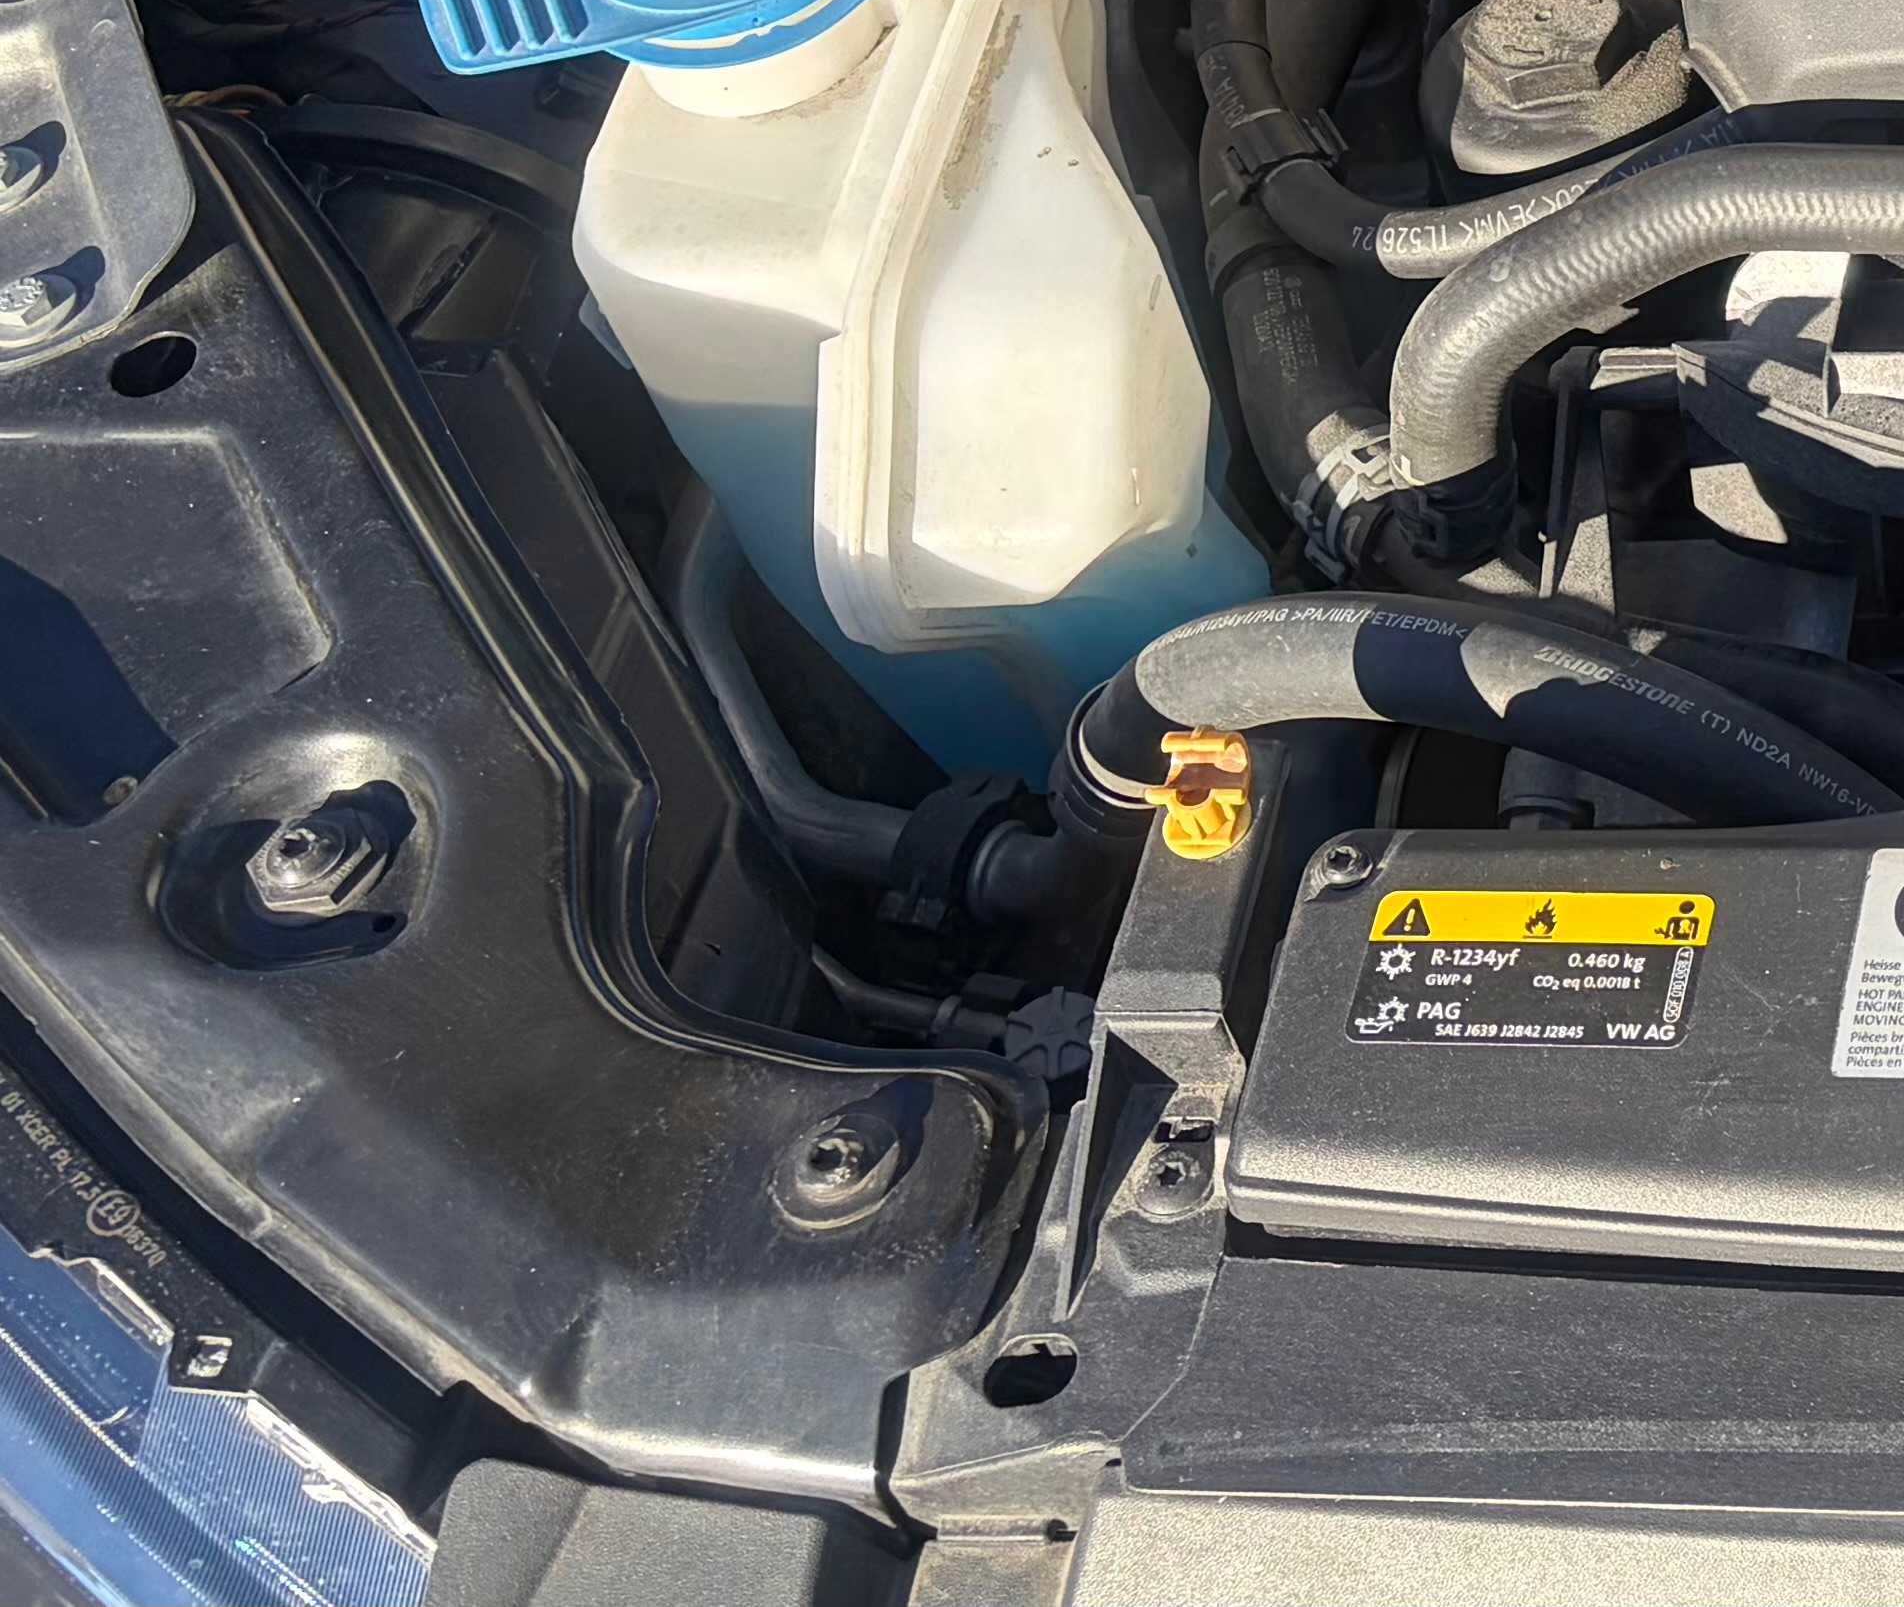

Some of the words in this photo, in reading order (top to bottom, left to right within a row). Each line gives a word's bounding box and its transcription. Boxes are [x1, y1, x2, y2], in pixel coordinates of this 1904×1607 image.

[1532, 643, 1695, 716] BRIDGESTONE
[1700, 709, 1732, 736] (T)
[1735, 727, 1793, 770] ND2A
[1430, 948, 1521, 971] R-1234yf
[1567, 953, 1621, 969] 0.460
[1623, 953, 1646, 973] kg
[1863, 959, 1901, 972] Heisse
[1425, 974, 1460, 986] GWP
[1462, 974, 1473, 986] 4
[1562, 978, 1581, 993] eq
[1633, 977, 1641, 990] t
[1858, 989, 1885, 1001] HOT
[1416, 1001, 1462, 1019] PAG
[1856, 1001, 1904, 1014] ENGINE
[1435, 1024, 1463, 1037] SAE
[1464, 1024, 1497, 1037] J639
[1500, 1024, 1541, 1038] J2842
[1544, 1025, 1584, 1039] J2845
[1606, 1023, 1642, 1040] VW
[1643, 1025, 1676, 1041] AG
[1850, 1030, 1885, 1044] Pièces
[1846, 1056, 1883, 1069] Pièces
[1885, 1058, 1902, 1069] en
[49, 1147, 74, 1173] PL
